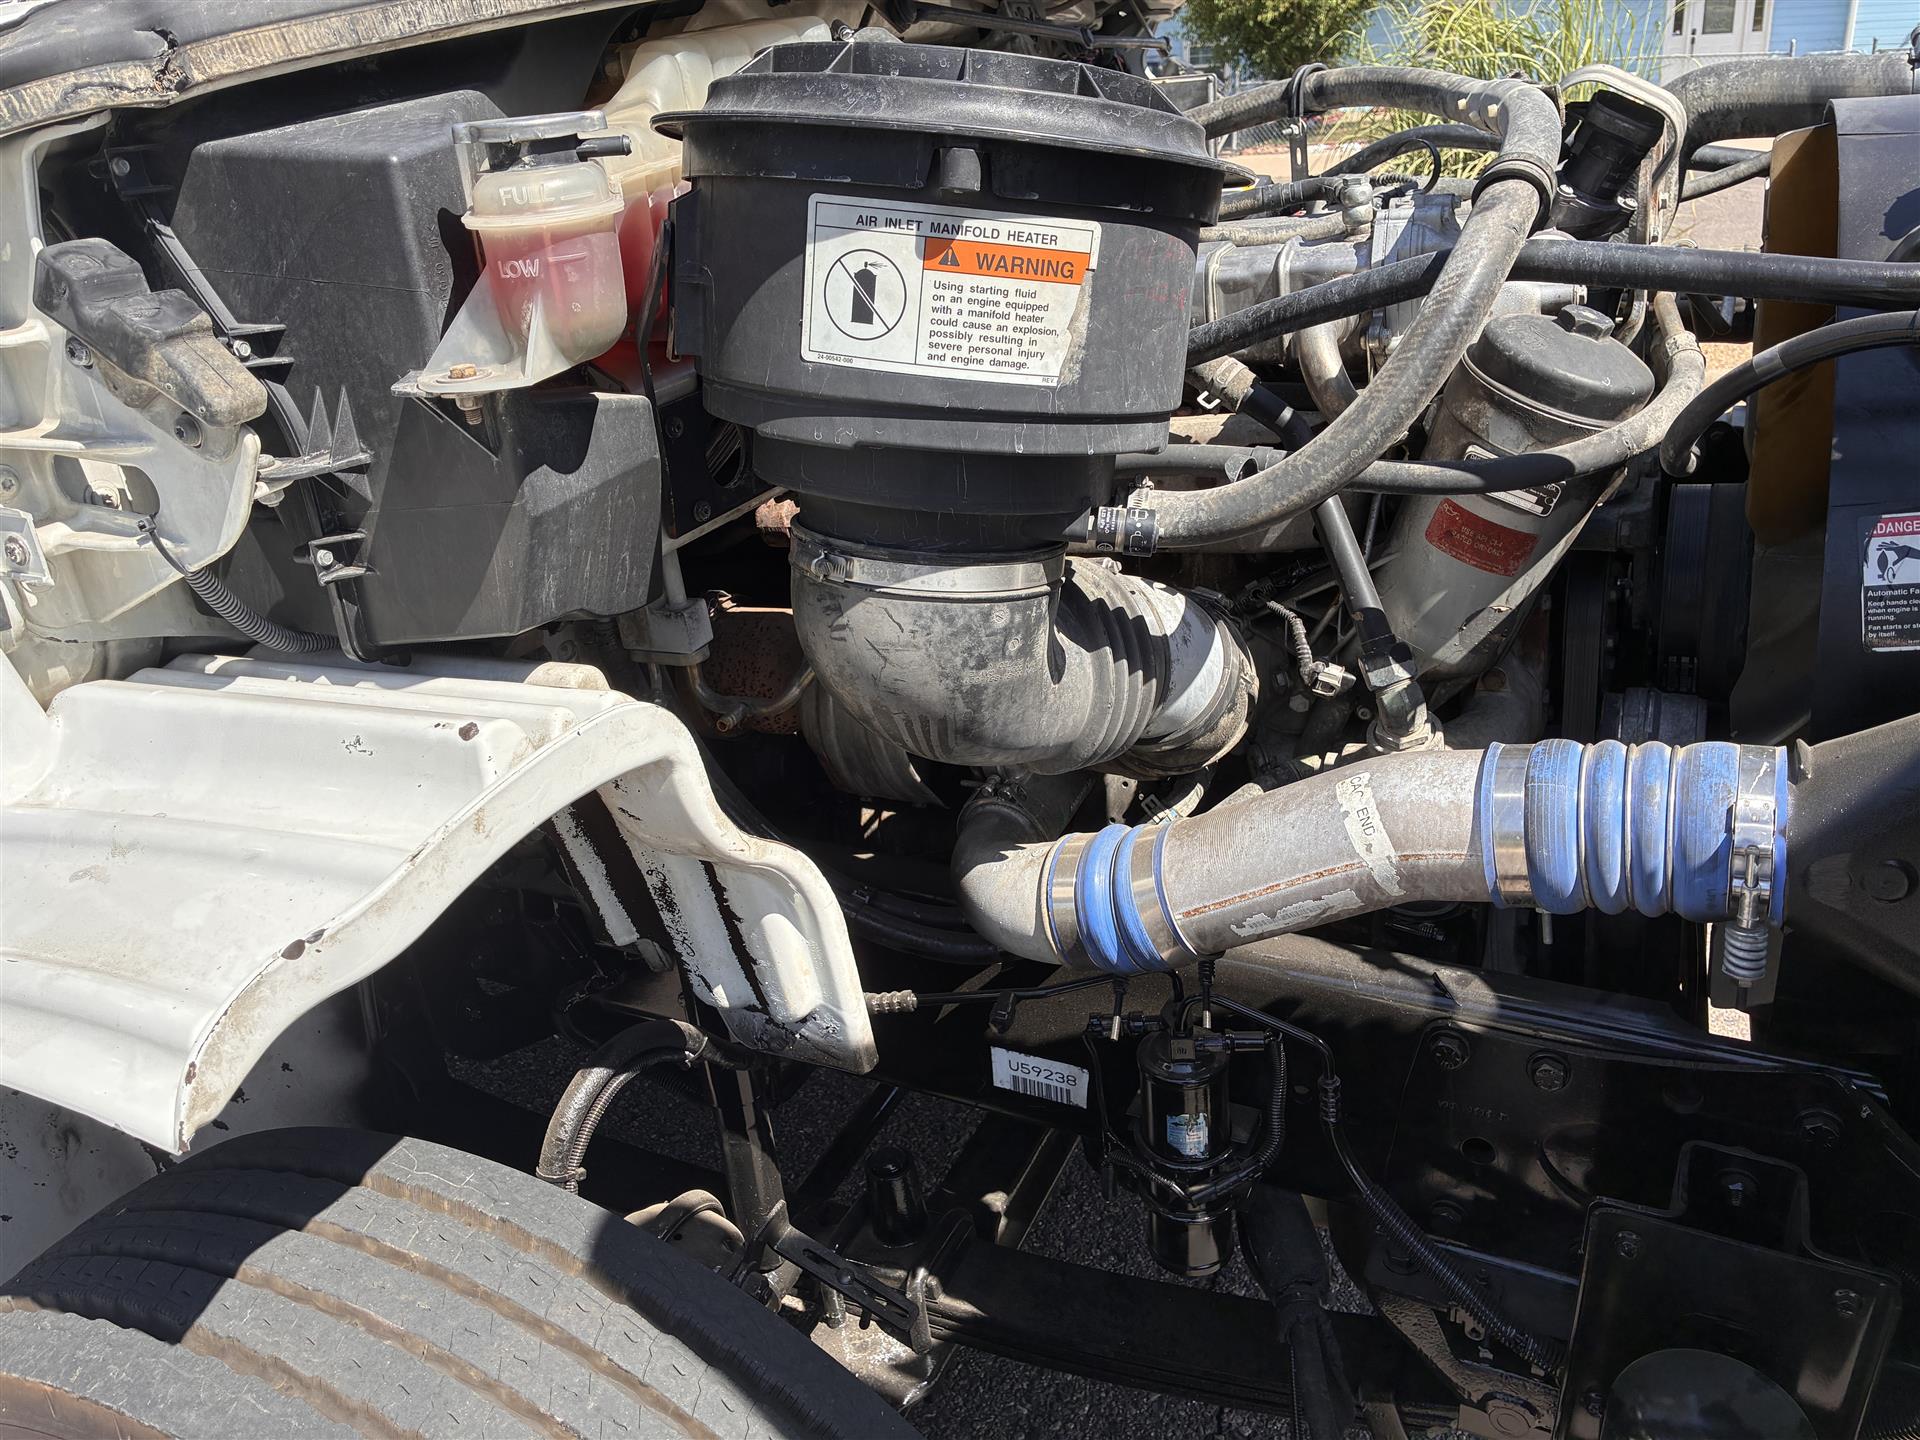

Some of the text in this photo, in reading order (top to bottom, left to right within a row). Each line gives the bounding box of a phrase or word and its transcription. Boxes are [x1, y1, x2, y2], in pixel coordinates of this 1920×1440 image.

[499, 183, 555, 206] FULL
[856, 214, 1058, 246] AIR INLET MANIFOLD HEATER
[498, 258, 540, 279] LOW
[975, 252, 1074, 279] WARNING
[933, 280, 1037, 299] Using starting fluid
[932, 294, 1050, 313] on an engine equipped
[931, 305, 1044, 323] with a manifold heater
[930, 317, 1060, 338] could cause an explosion,
[929, 329, 1038, 348] possibly resulting in
[928, 341, 1045, 360] severe personal injury
[927, 352, 1030, 370] and engine damage.
[1867, 589, 1908, 597] Automatic
[1887, 606, 1911, 614] engine
[1356, 807, 1376, 837] END
[1008, 1059, 1077, 1087] U59238
